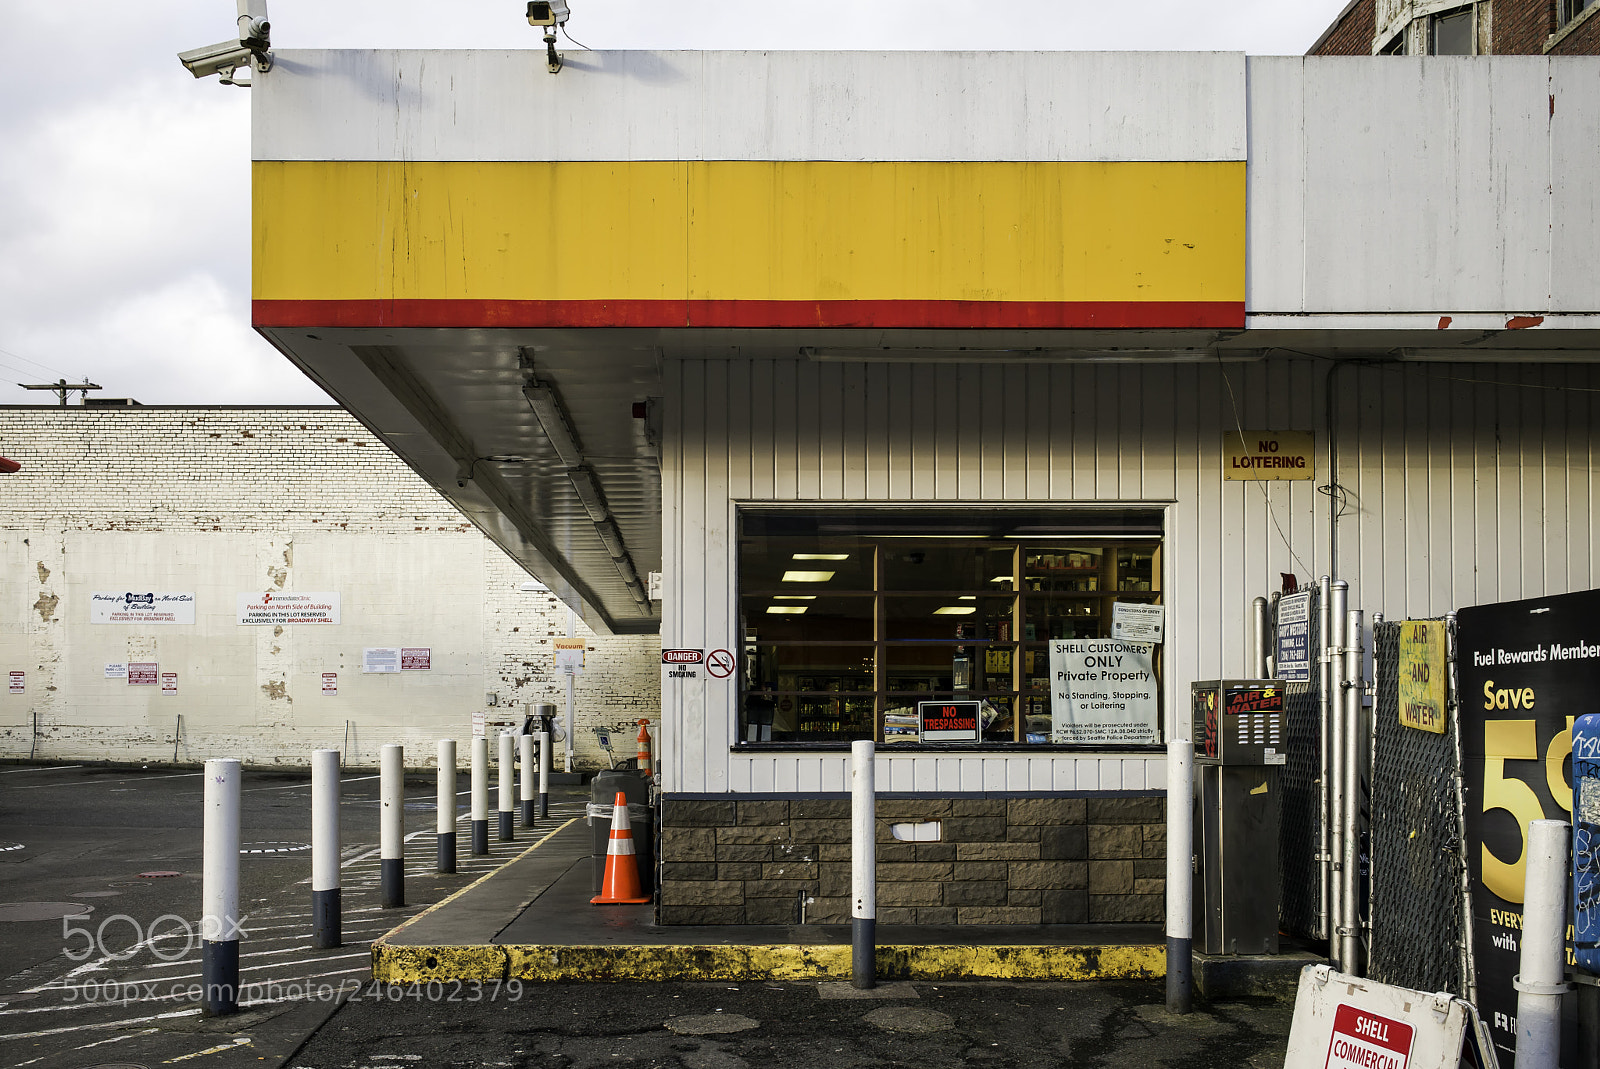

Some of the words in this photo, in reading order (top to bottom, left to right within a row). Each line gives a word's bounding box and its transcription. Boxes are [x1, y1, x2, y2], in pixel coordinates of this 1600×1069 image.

[1258, 440, 1279, 452] NO
[1232, 456, 1305, 468] LOITERING
[1413, 624, 1427, 644] AIR
[1056, 644, 1085, 654] SHELL
[1088, 644, 1147, 654] CUSTOMERS
[668, 653, 698, 661] DANGER
[1084, 656, 1123, 668] ONLY
[1474, 648, 1495, 666] Fuel
[1058, 671, 1097, 681] Private
[1101, 670, 1149, 682] Property
[1412, 663, 1430, 683] AND
[1072, 692, 1110, 700] Standing,
[1112, 691, 1150, 700] Stopping,
[1232, 691, 1260, 704] AIR
[1263, 688, 1276, 698] &
[1484, 680, 1535, 710] Save
[942, 706, 957, 718] NO
[1091, 702, 1125, 710] Loitering
[1226, 697, 1282, 715] WATER
[1405, 702, 1434, 726] WATER
[924, 718, 976, 730] TRESPASSING
[1492, 933, 1516, 952] with
[1355, 1016, 1389, 1042] SHELL
